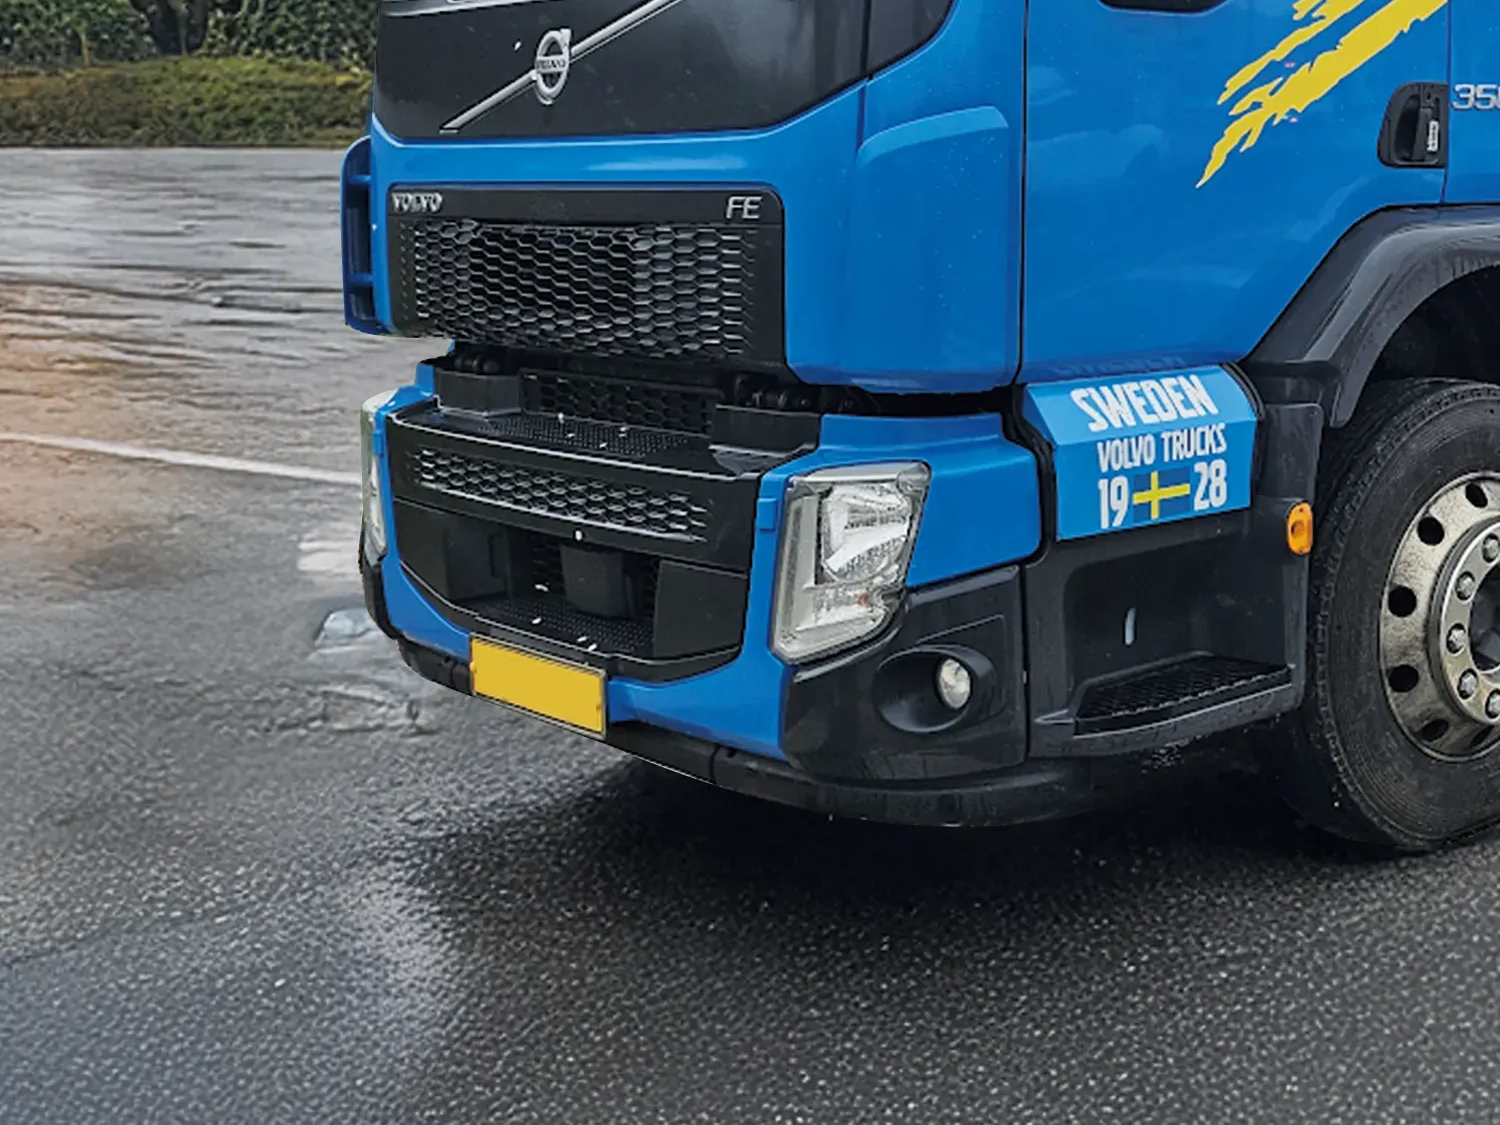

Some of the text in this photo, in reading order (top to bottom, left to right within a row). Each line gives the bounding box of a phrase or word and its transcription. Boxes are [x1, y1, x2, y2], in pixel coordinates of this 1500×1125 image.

[391, 192, 443, 213] VOLVO
[726, 196, 762, 219] FE
[1070, 374, 1219, 433] SWEDEN
[1097, 422, 1227, 473] VOLVO TRUCKS
[1098, 459, 1228, 530] 19 28
